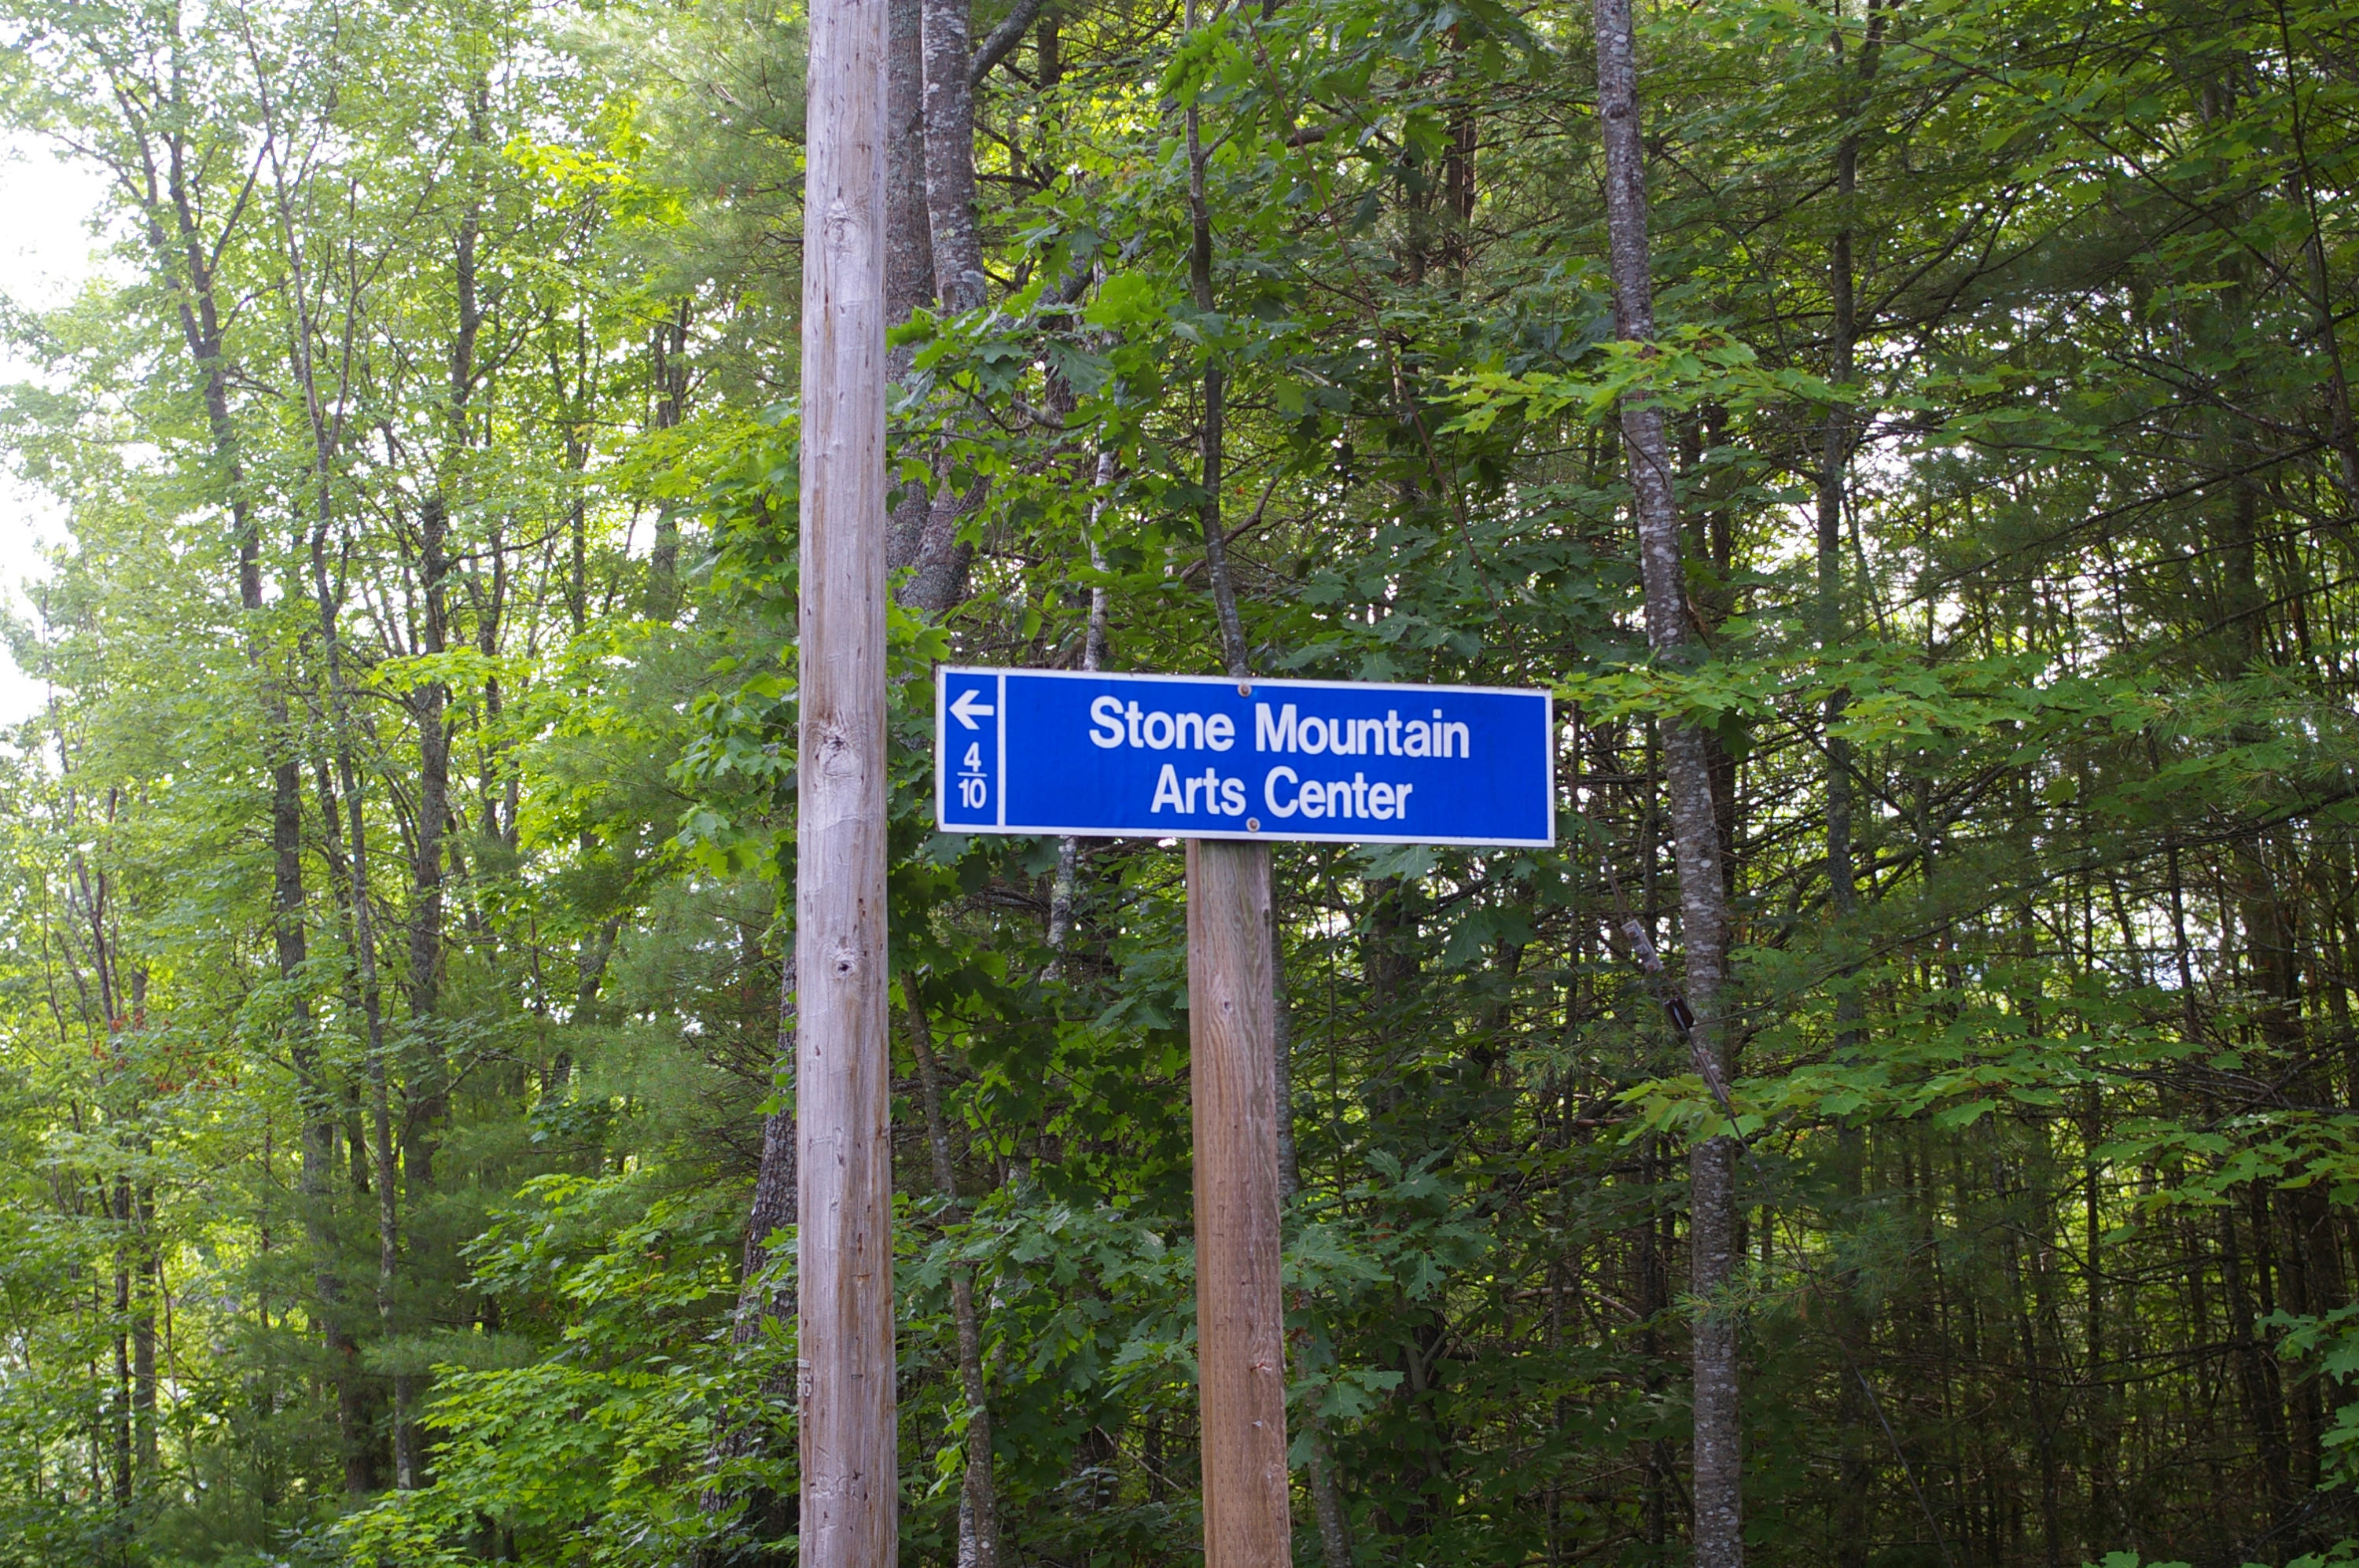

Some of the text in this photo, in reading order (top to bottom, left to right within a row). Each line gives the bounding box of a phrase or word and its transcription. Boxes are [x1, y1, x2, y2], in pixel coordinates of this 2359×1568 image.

[1089, 695, 1470, 758] Stone Mountain
[963, 742, 981, 773] 4
[959, 778, 987, 809] 10
[1150, 764, 1413, 820] Arts Center
